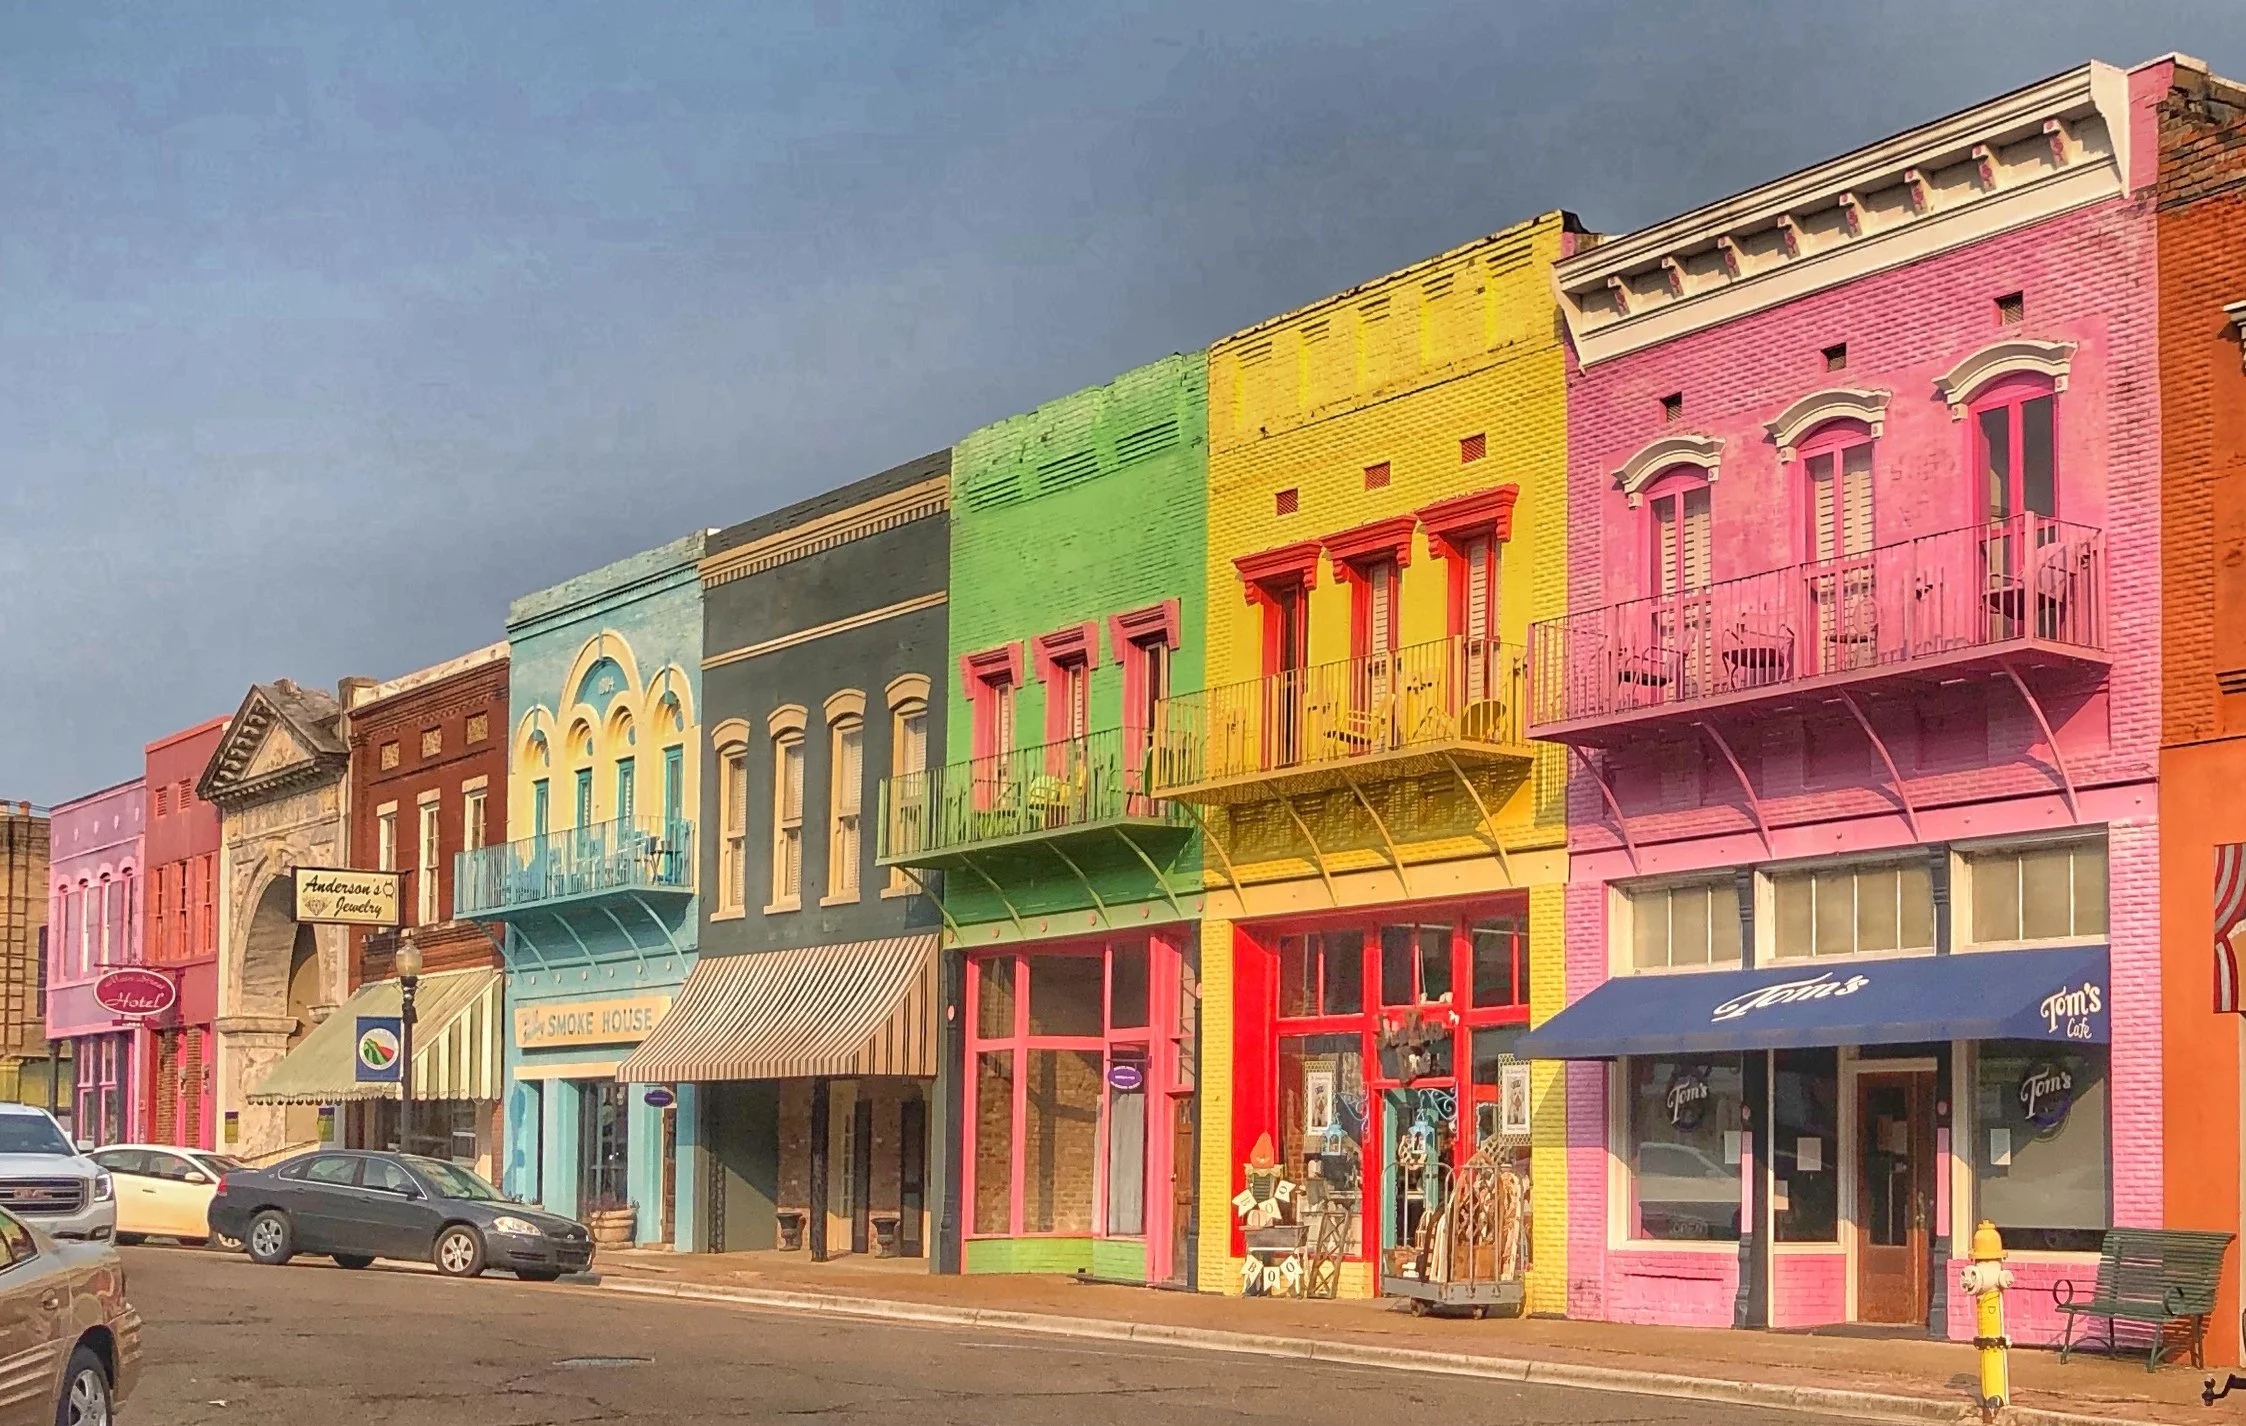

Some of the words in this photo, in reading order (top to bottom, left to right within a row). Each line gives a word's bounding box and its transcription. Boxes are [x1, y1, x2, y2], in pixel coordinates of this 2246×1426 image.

[303, 874, 381, 895] Anderson's
[334, 896, 382, 918] Jewelry
[104, 992, 165, 1008] Hotel
[1711, 972, 1869, 1022] Tom's
[2040, 982, 2102, 1033] Tom's
[547, 1012, 594, 1037] SMOKE
[602, 1008, 652, 1034] HOUSE
[2067, 1017, 2093, 1039] Cafe
[1667, 1081, 1707, 1124] Tom's
[2020, 1067, 2072, 1119] Tom's
